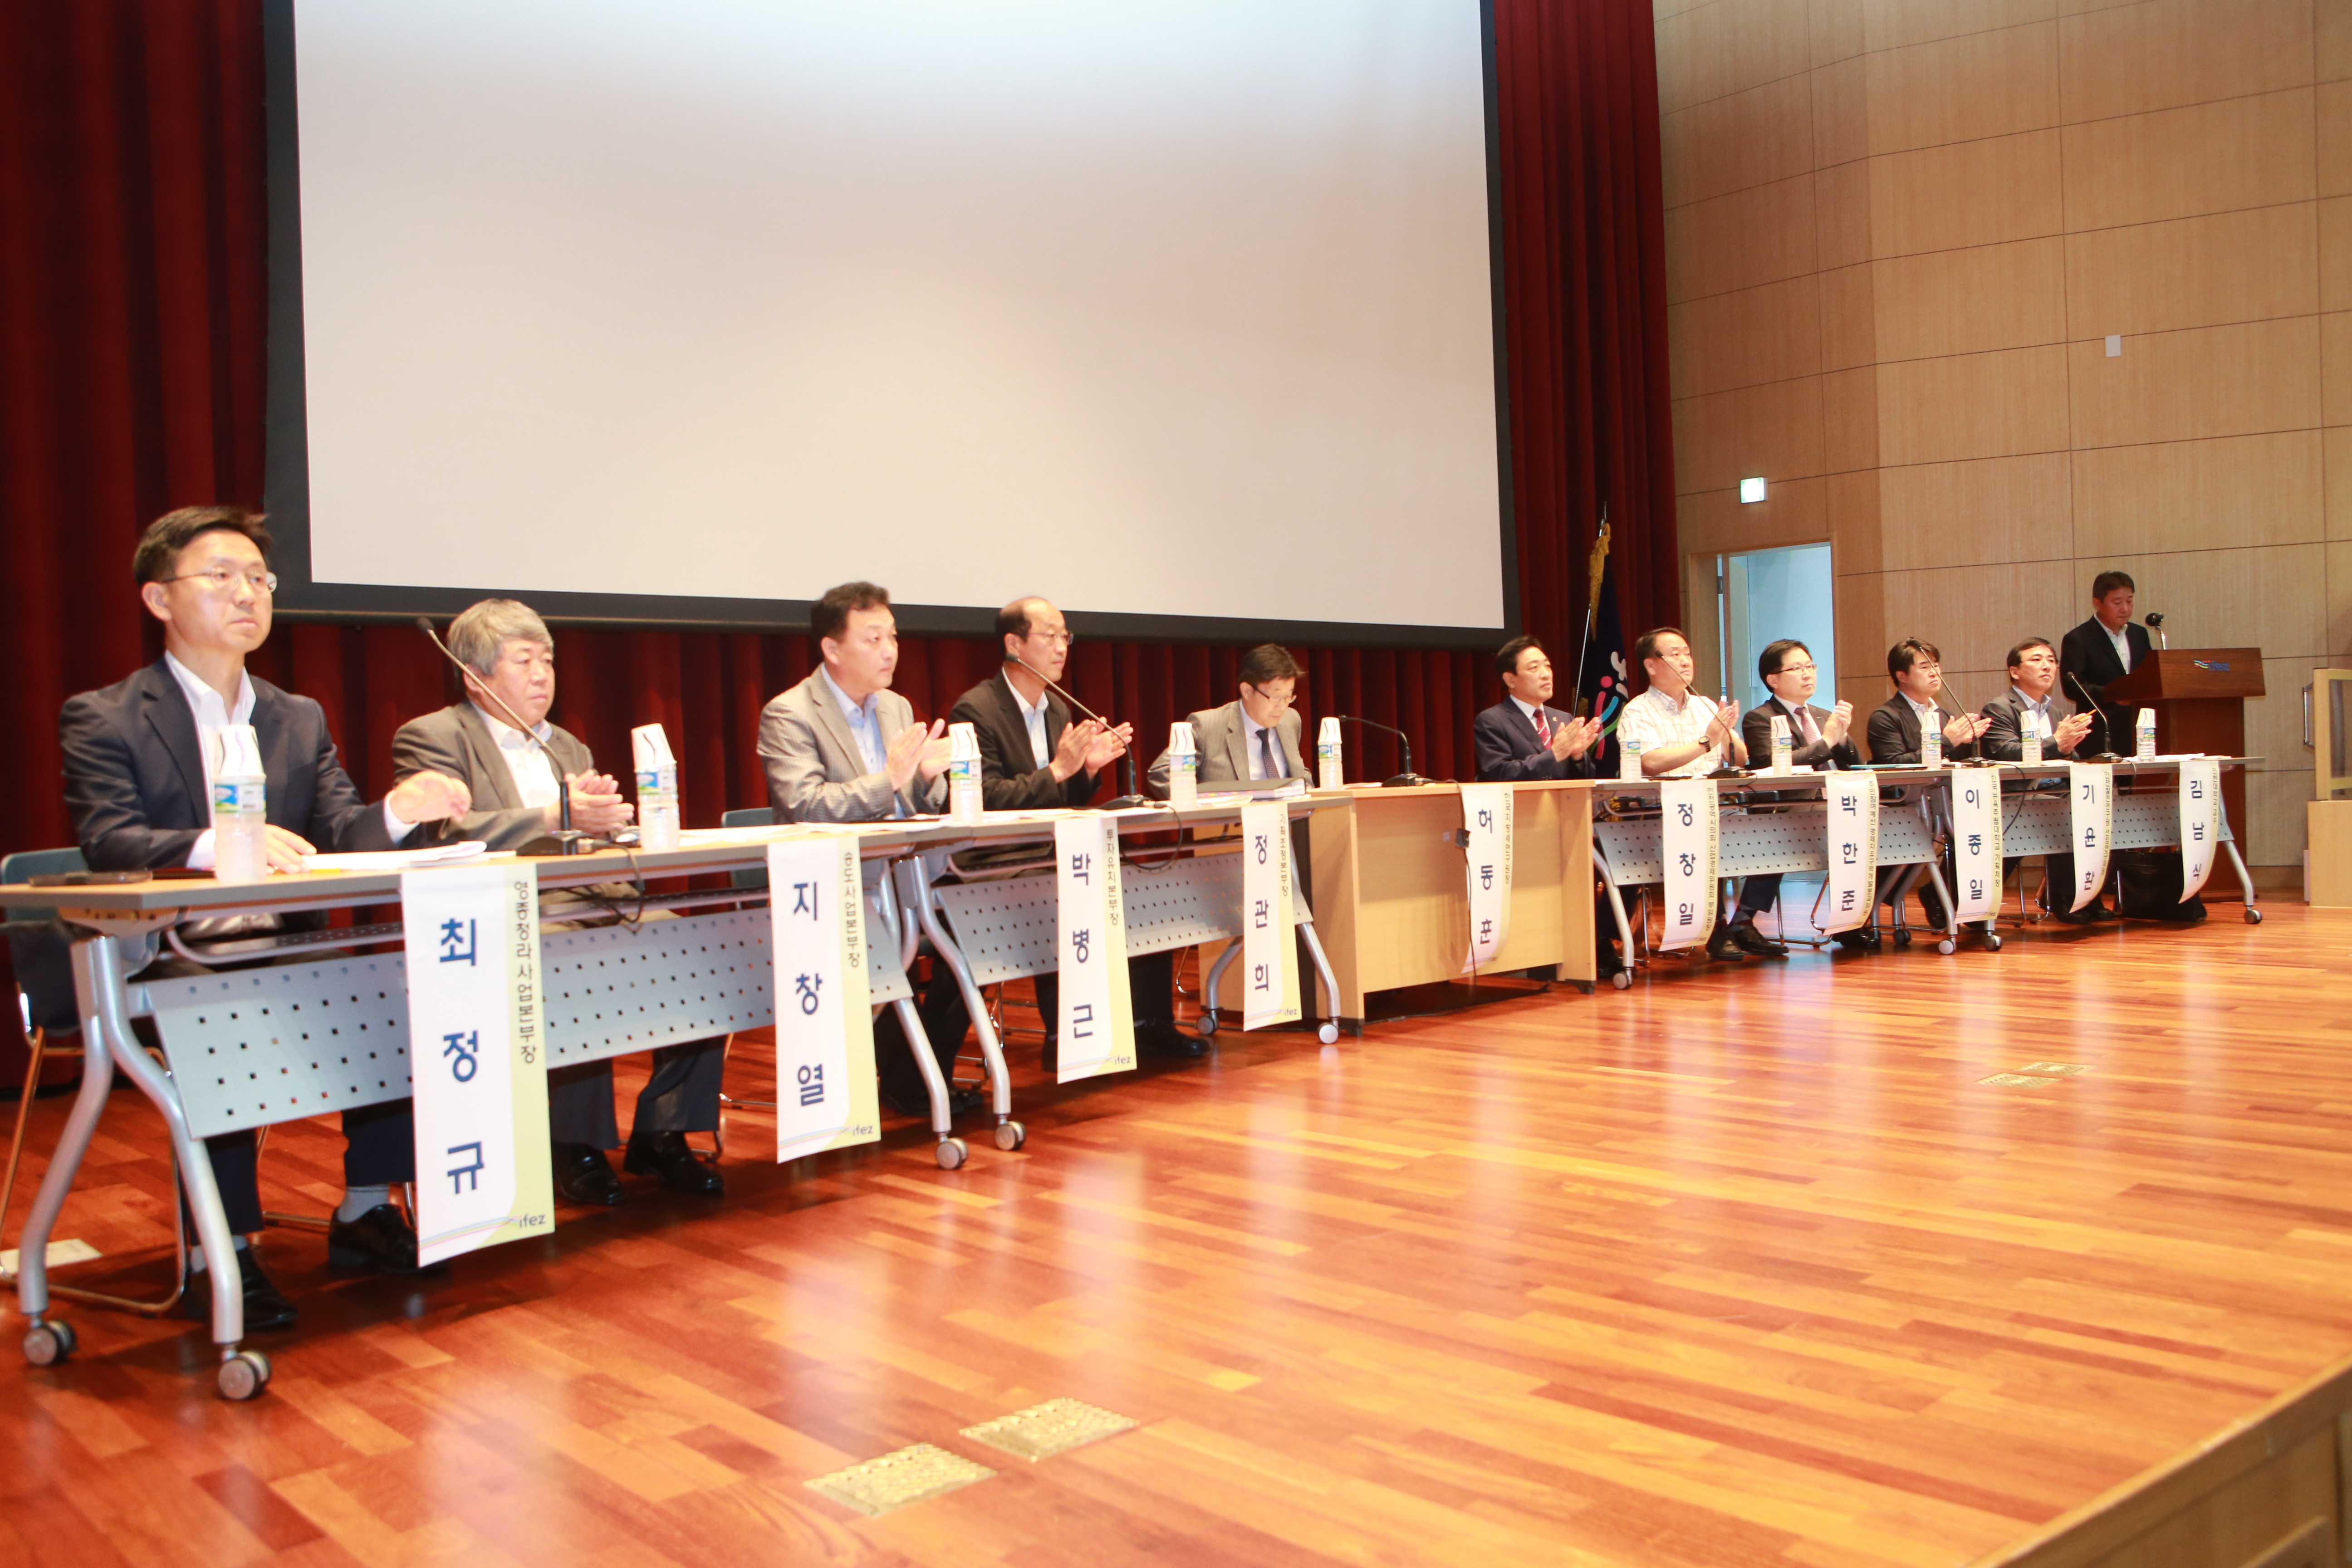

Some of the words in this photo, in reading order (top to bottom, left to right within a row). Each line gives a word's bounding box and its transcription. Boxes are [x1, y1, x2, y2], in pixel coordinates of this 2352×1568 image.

[1280, 814, 1288, 897] 기획조정본부장
[1678, 804, 1695, 925] 정창일
[1708, 788, 1716, 842] 인천광역시의회
[1841, 796, 1857, 911] 박한준
[1966, 789, 1982, 900] 이종일
[2082, 785, 2096, 891] 기윤환
[2190, 780, 2204, 880] 김남식
[2213, 809, 2217, 823] 교수
[843, 852, 861, 967] 송도사업본부장
[1107, 829, 1119, 925] 투자유치본부장
[1255, 835, 1269, 991] 정관희
[1479, 809, 1493, 944] 허동훈
[514, 882, 537, 1063] 영종청라사업본부장
[794, 882, 824, 1106] 지창열
[1073, 853, 1093, 1039] 박병근
[440, 917, 485, 1194] 최정규
[1114, 1055, 1131, 1065] ifez
[852, 1125, 873, 1137] ifez
[519, 1213, 546, 1228] ifez
